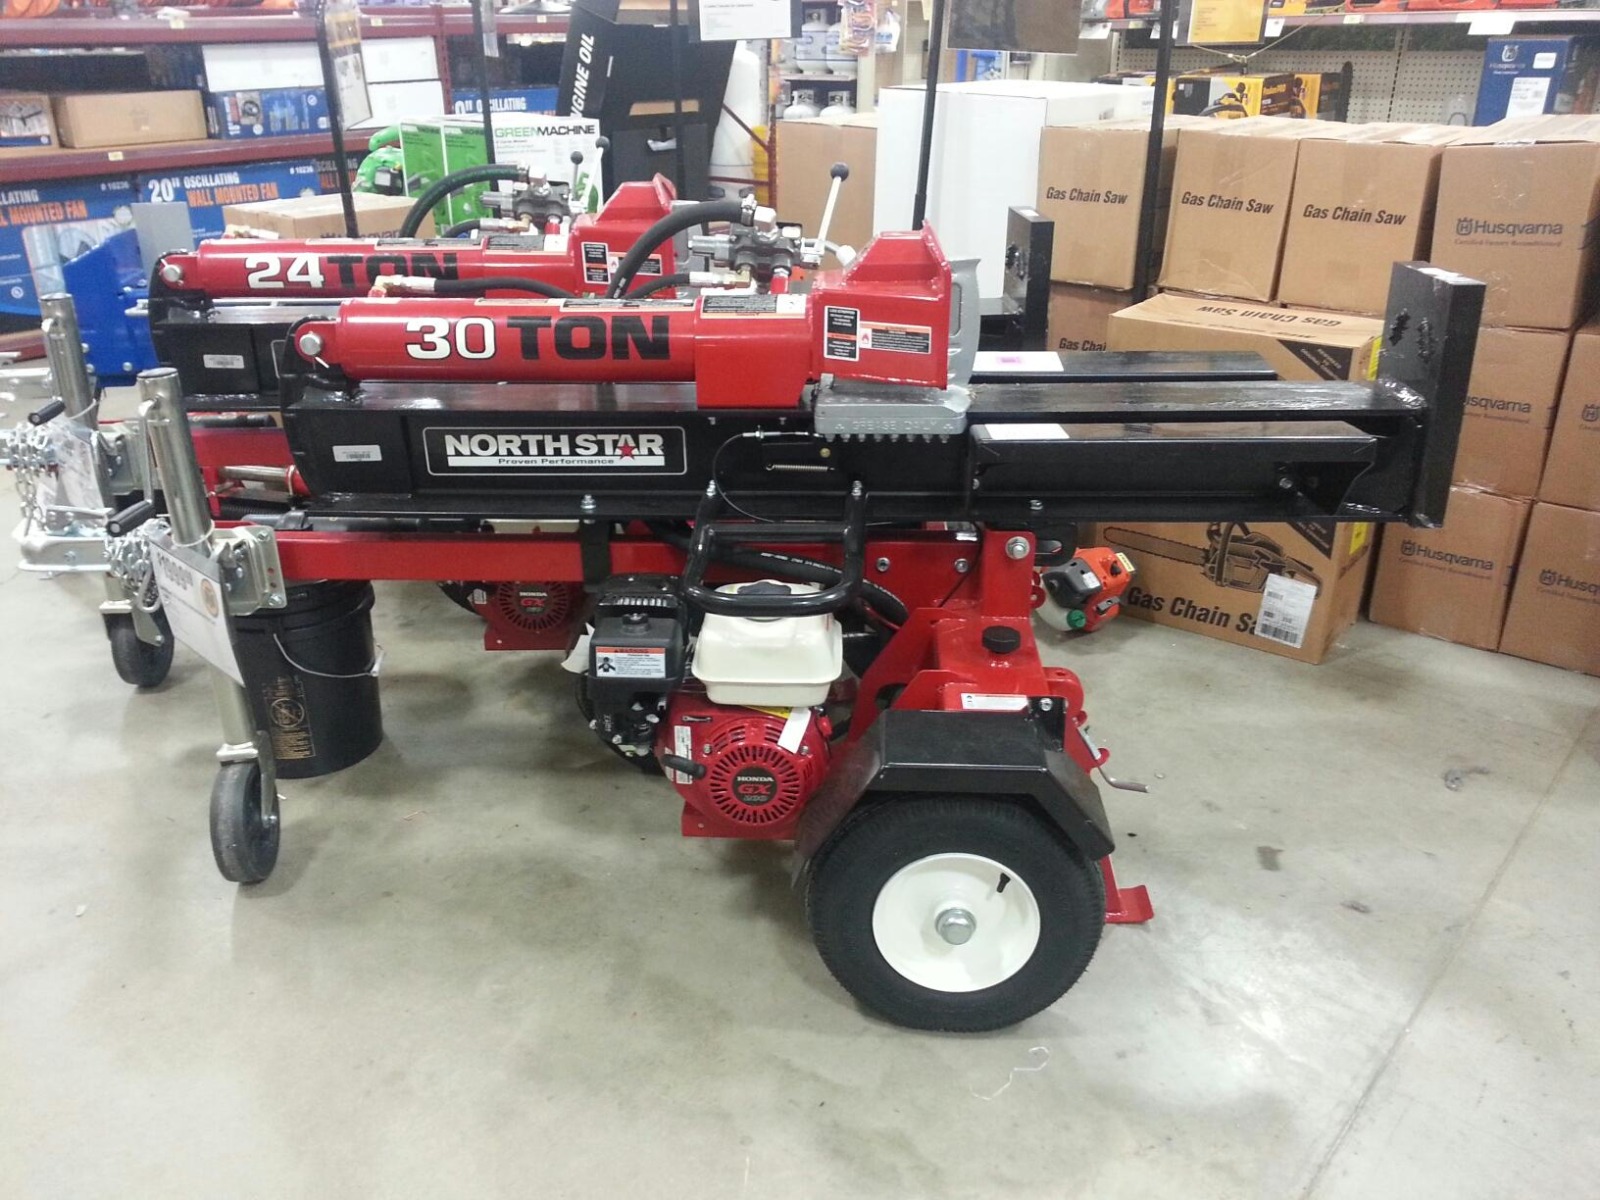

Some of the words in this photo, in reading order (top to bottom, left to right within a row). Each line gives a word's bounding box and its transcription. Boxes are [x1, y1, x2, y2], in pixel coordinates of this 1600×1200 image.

[579, 33, 595, 64] OIL
[569, 63, 590, 117] NGINE
[476, 96, 526, 113] OCILLATING
[494, 124, 596, 138] GREENMACHINE
[0, 189, 39, 204] LATING
[147, 177, 181, 203] 20"
[183, 171, 240, 189] OSCILLATING
[186, 188, 214, 207] WALL
[215, 184, 260, 205] MOUNTED
[261, 181, 279, 200] FAN
[1046, 186, 1067, 201] Gas
[1068, 187, 1101, 203] Chain
[1103, 190, 1128, 205] Saw
[9, 202, 64, 224] MOUNTED
[65, 199, 88, 219] FAN
[1181, 191, 1205, 207] Gas
[1207, 193, 1244, 212] Chain
[1246, 198, 1274, 215] Saw
[1303, 203, 1328, 219] Gas
[1332, 206, 1372, 223] Chain
[1375, 209, 1407, 226] Saw
[1473, 219, 1563, 237] Husqvarna
[244, 254, 326, 289] 24
[327, 251, 460, 289] TON
[1196, 305, 1238, 317] Saw
[1239, 309, 1299, 323] Chain
[1301, 316, 1342, 328] Gas
[404, 316, 496, 361] 30
[506, 314, 671, 361] TON
[1059, 337, 1080, 351] Gas
[1081, 339, 1106, 352] Chai
[1463, 395, 1530, 413] usqvarna
[541, 458, 615, 466] Performance
[1415, 544, 1494, 571] Husqvarna
[1127, 586, 1165, 612] Gas
[1169, 596, 1231, 628] Chain
[1235, 612, 1257, 636] Sa
[737, 783, 773, 795] GX
